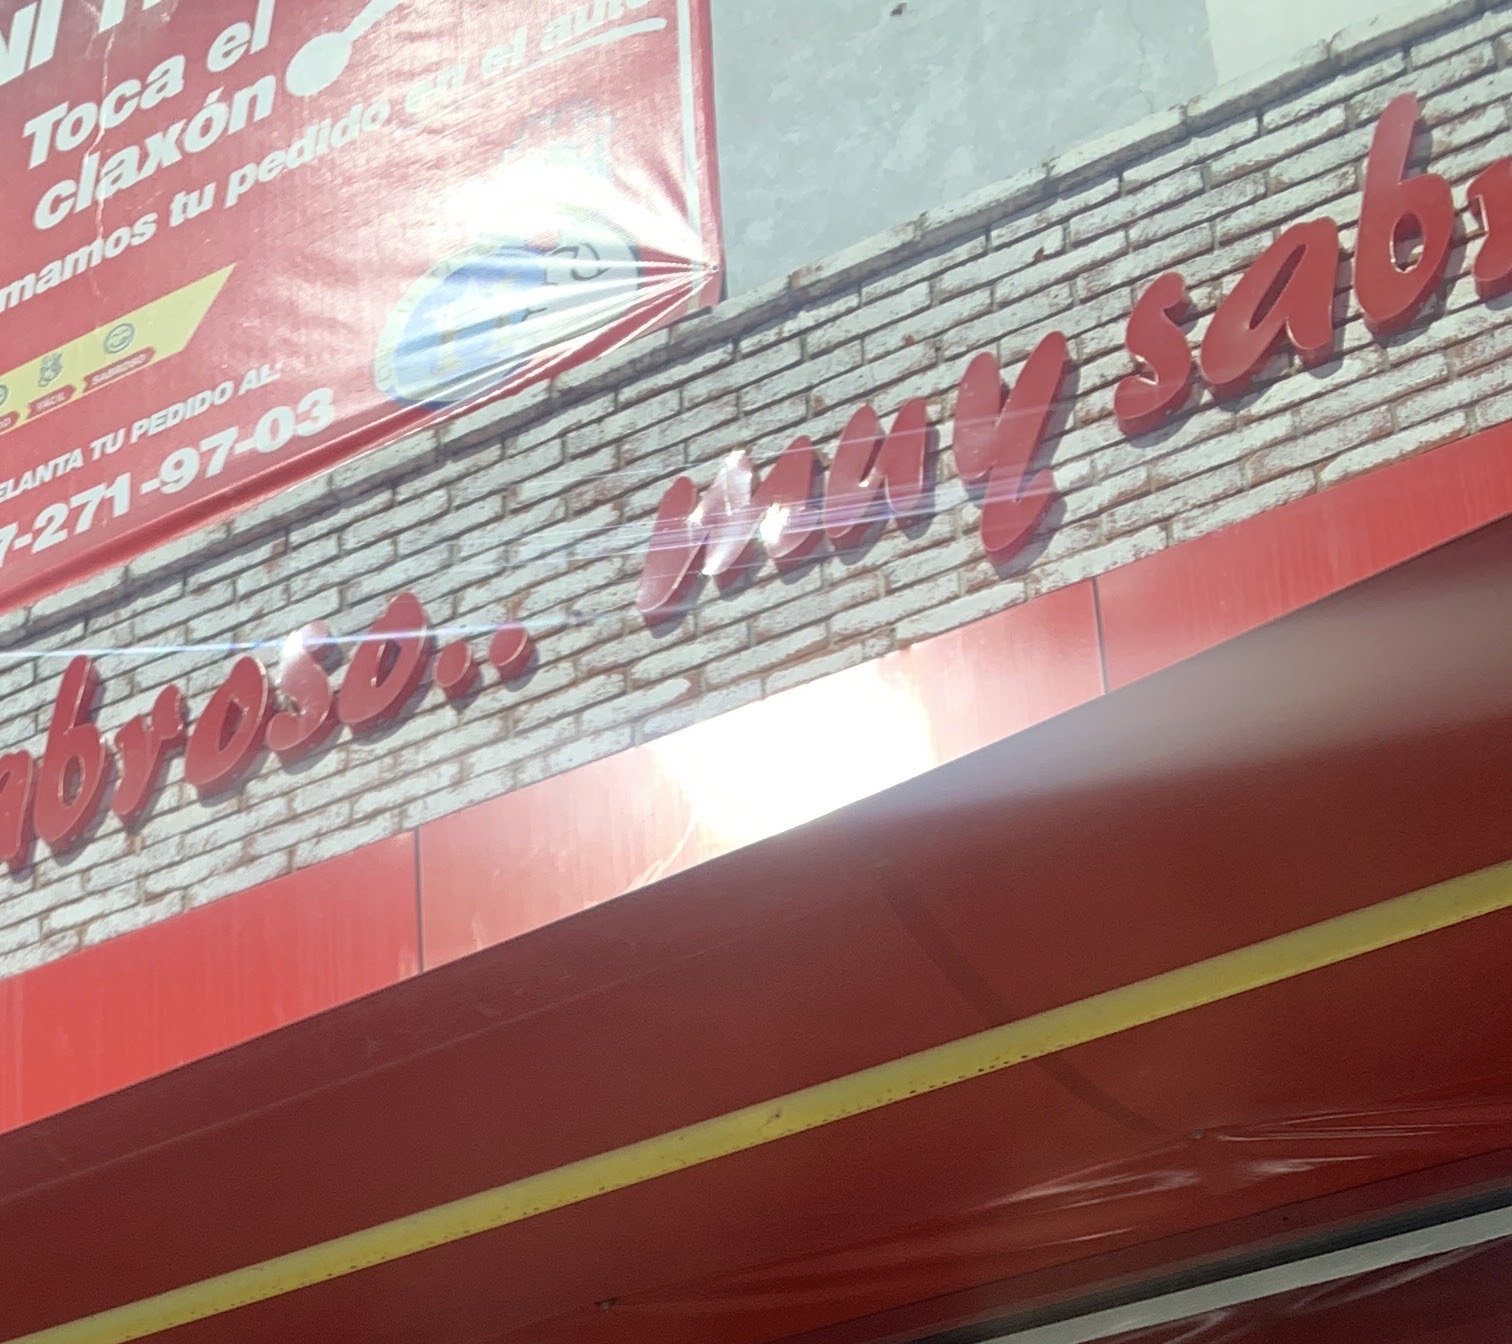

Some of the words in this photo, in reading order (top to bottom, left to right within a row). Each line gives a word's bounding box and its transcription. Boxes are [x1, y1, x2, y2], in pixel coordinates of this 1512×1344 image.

[22, 55, 185, 170] Toca
[207, 0, 276, 72] el
[34, 75, 276, 230] claxón
[169, 182, 218, 227] tu
[224, 98, 391, 208] pedido
[405, 63, 467, 111] en
[481, 28, 527, 80] el
[90, 428, 126, 463] TU
[129, 380, 235, 446] PEDIDO
[635, 331, 1070, 627] muy
